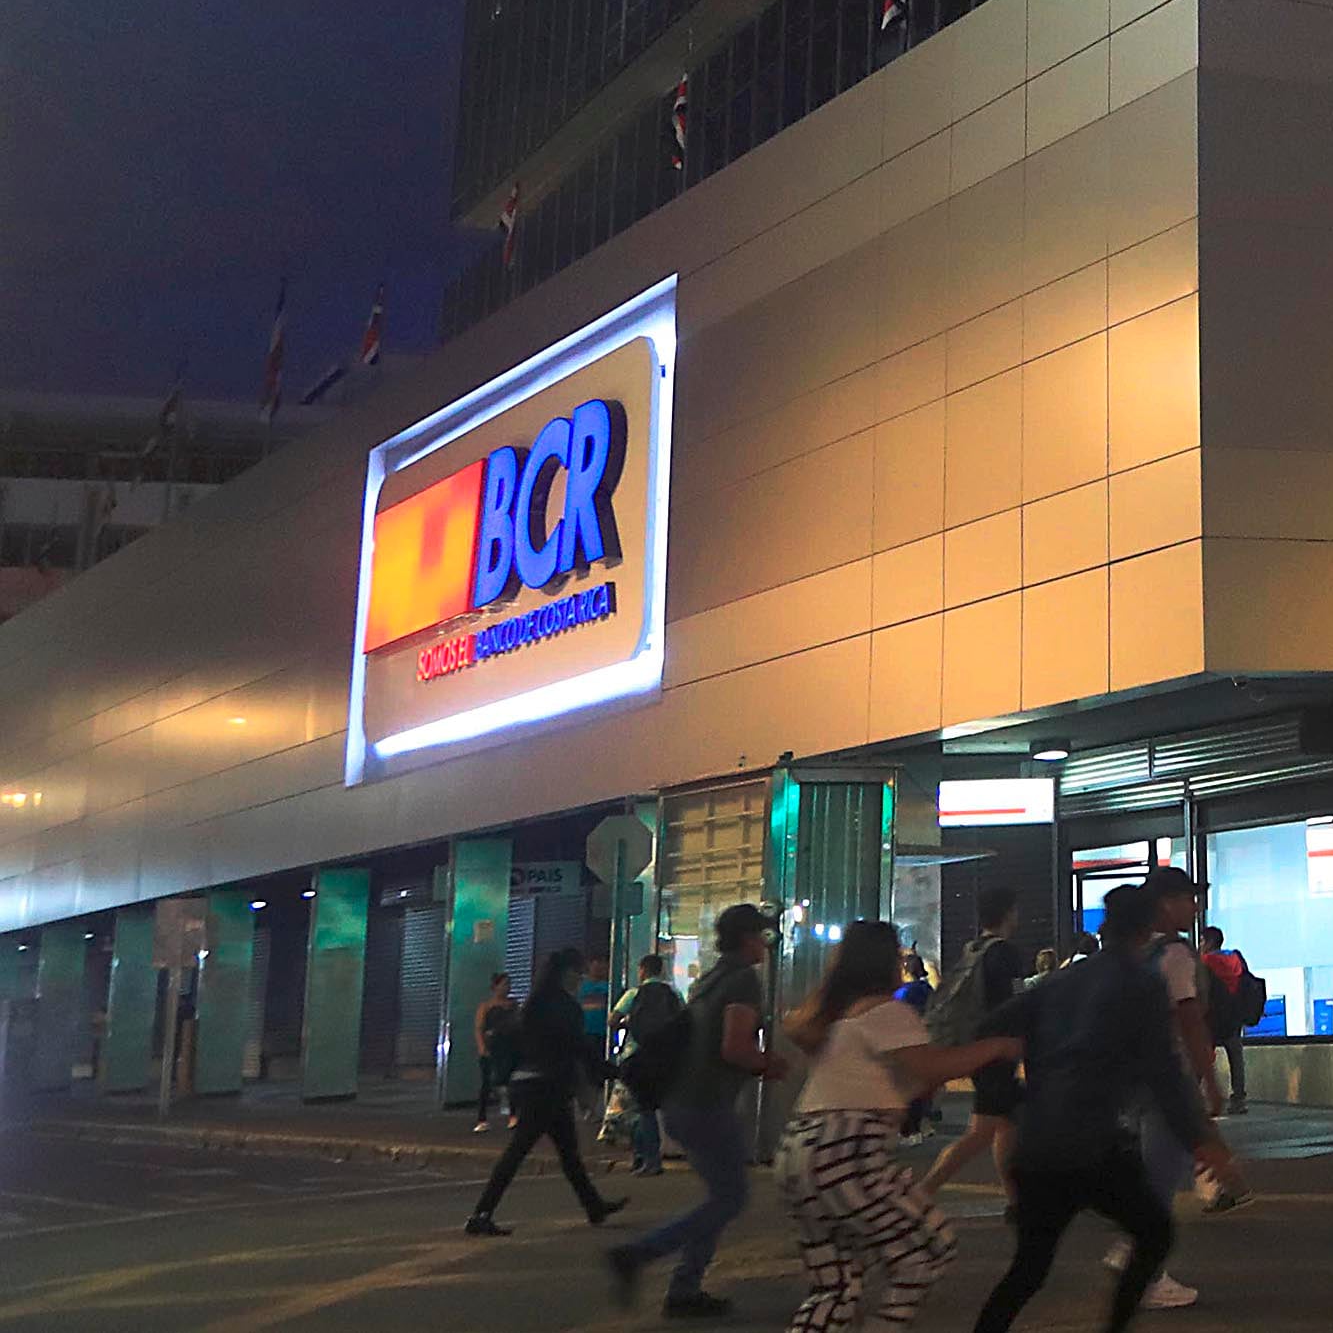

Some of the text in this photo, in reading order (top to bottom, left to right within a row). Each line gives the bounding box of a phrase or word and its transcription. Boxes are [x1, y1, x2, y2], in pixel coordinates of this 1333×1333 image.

[473, 399, 611, 608] BCR
[416, 638, 457, 681] SOMOS
[476, 618, 517, 660] BANCO
[537, 596, 576, 637] COSTA
[577, 585, 610, 624] RICA
